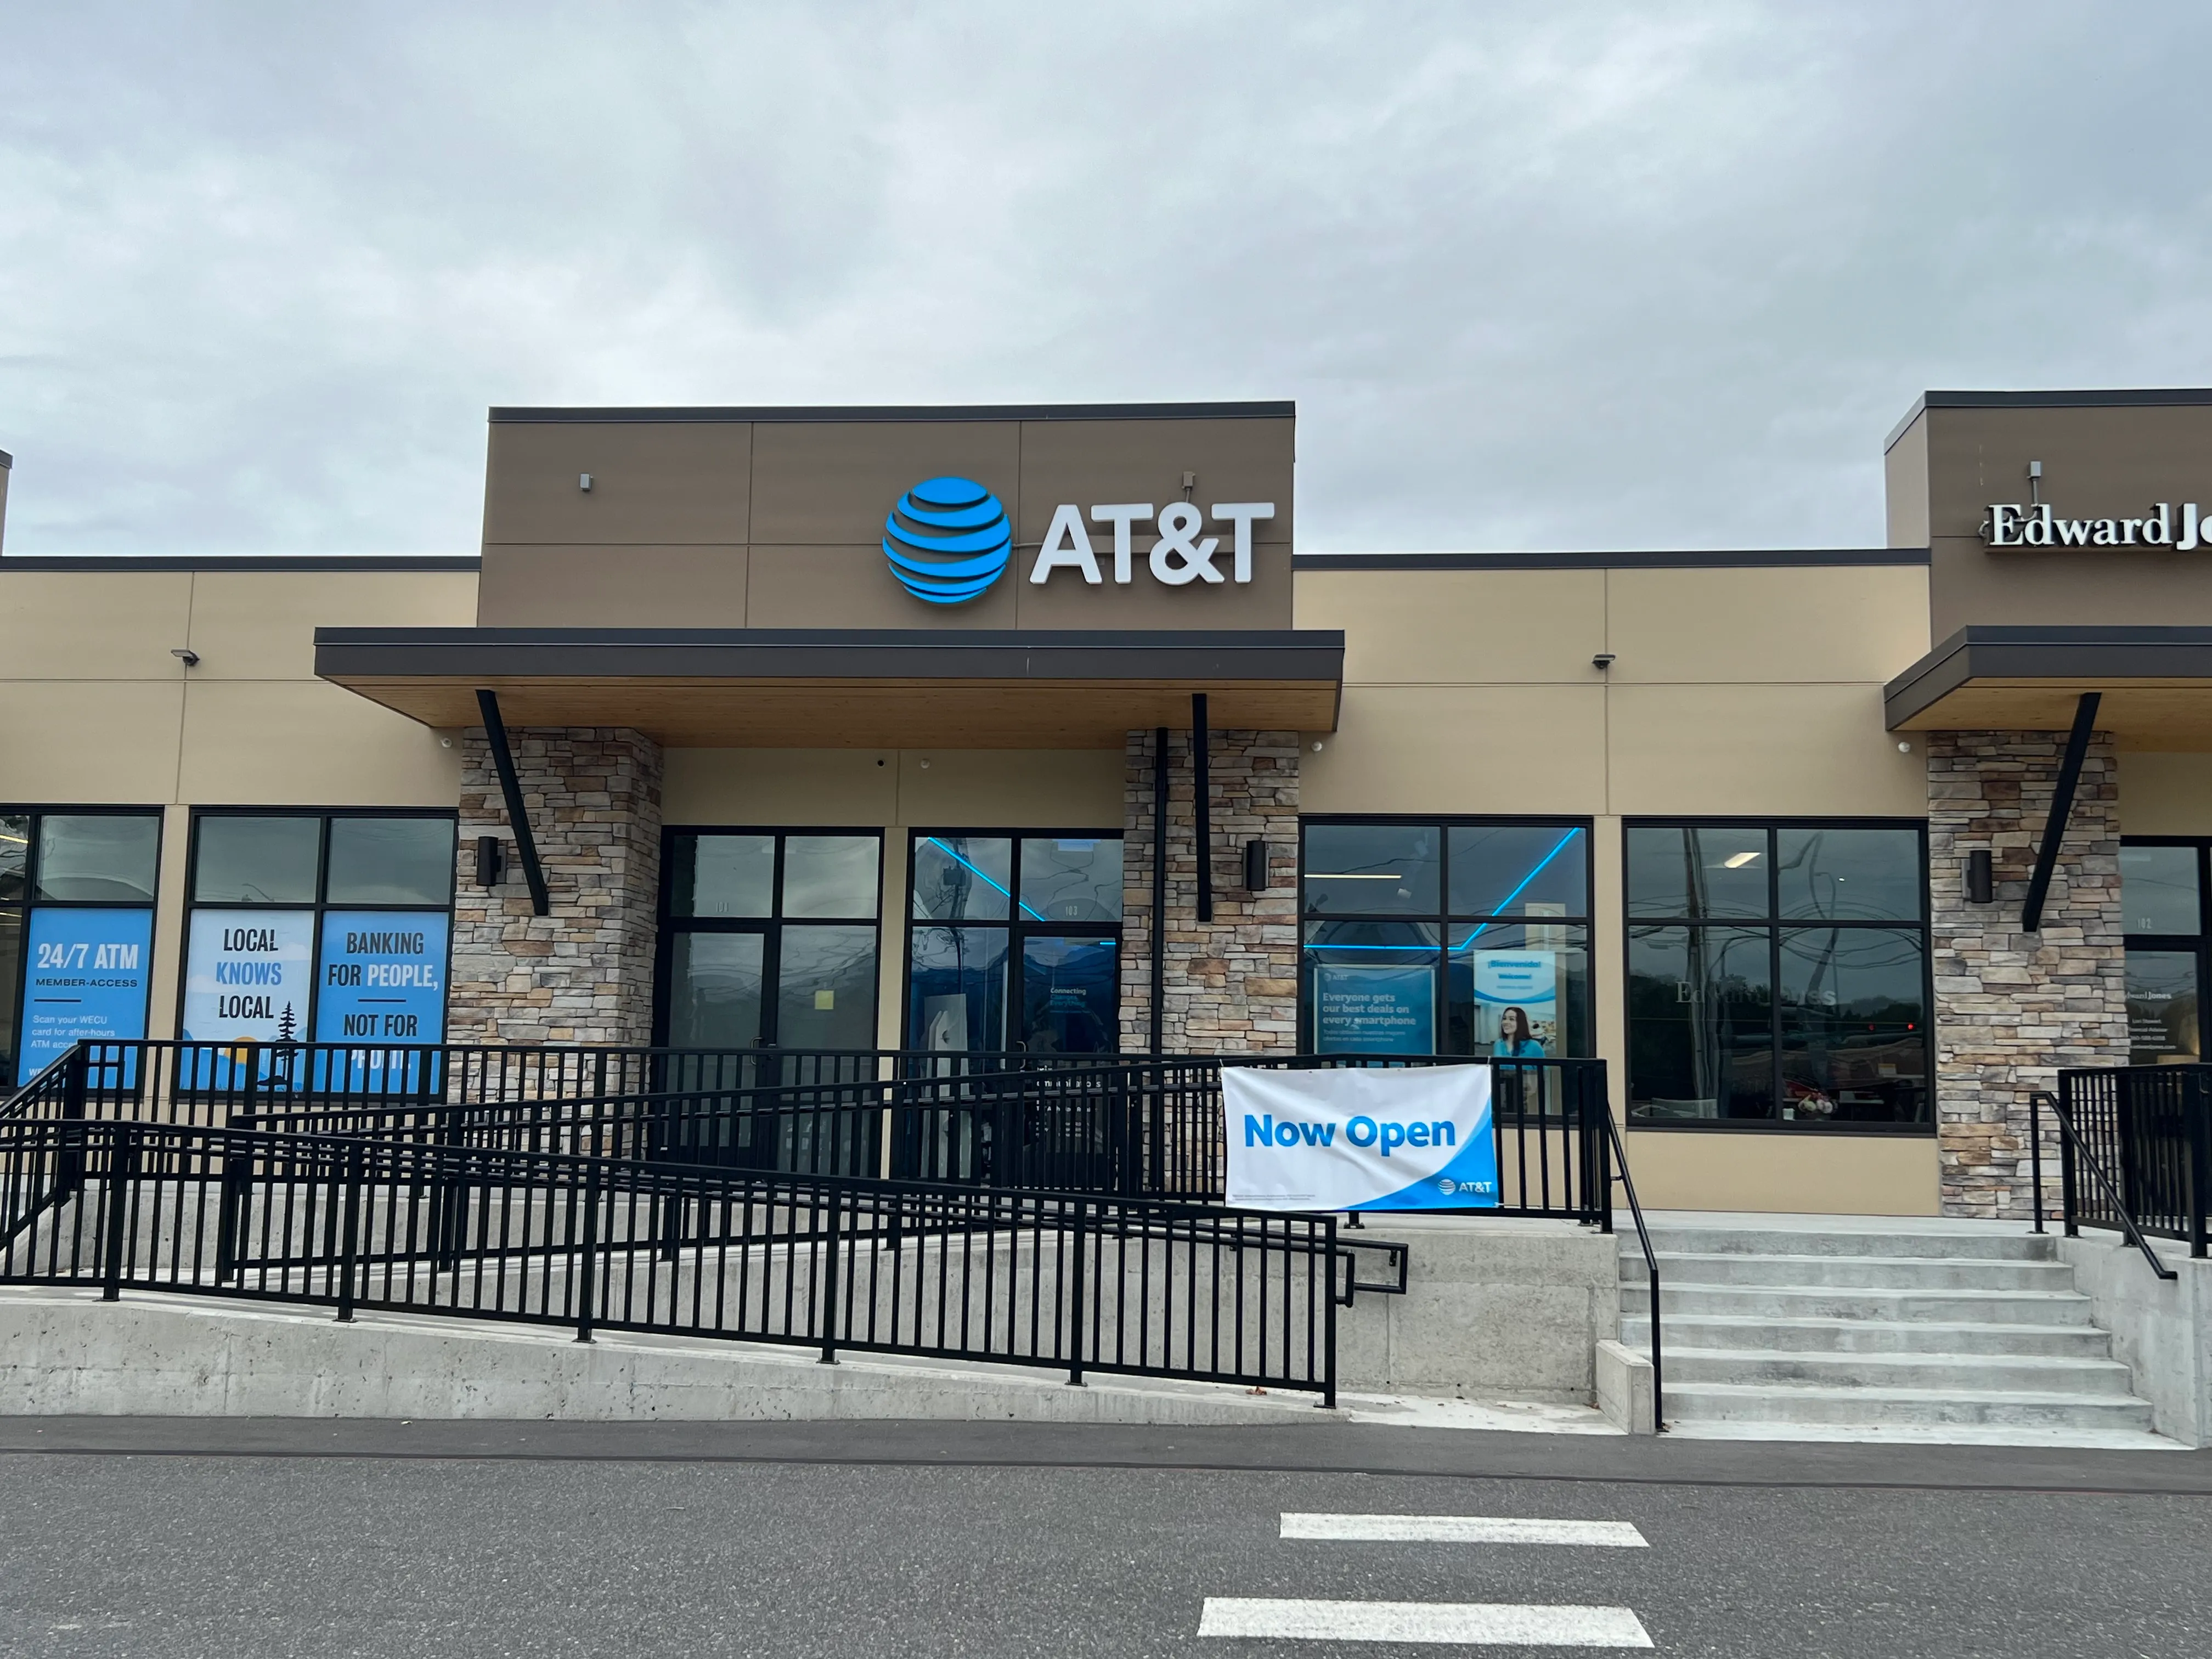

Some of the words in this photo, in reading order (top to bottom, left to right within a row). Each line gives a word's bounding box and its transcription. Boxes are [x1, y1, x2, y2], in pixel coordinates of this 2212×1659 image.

[1989, 503, 2172, 545] Edward
[1029, 502, 1275, 585] AT&T
[1065, 905, 1077, 916] 103
[2137, 917, 2153, 929] 102
[223, 928, 279, 952] LOCAL
[346, 932, 424, 954] BANKING
[37, 943, 89, 969] 24/7
[93, 944, 139, 969] ATM
[216, 962, 282, 985] KNOWS
[328, 964, 362, 986] FOR
[367, 964, 438, 991] PEOPLE,
[36, 978, 138, 987] MEMBER-ACCESS
[1050, 988, 1086, 996] Connecting
[1323, 992, 1370, 1003] Everyone
[1373, 994, 1396, 1004] gets
[219, 995, 274, 1019] LOCAL
[1342, 1004, 1365, 1013] best
[1367, 1004, 1394, 1013] deals
[33, 1015, 55, 1023] Scan
[58, 1017, 77, 1025] your
[80, 1016, 108, 1024] WECU
[343, 1014, 379, 1036] NOT
[384, 1014, 417, 1036] FOR
[1323, 1017, 1351, 1027] every
[1353, 1016, 1417, 1028] smartphone
[68, 1028, 115, 1037] after-hours
[31, 1040, 50, 1048] ATM
[348, 1048, 411, 1070] ROI.
[1244, 1114, 1336, 1147] Now
[1345, 1115, 1455, 1157] Open
[1458, 1181, 1493, 1194] AT&T
